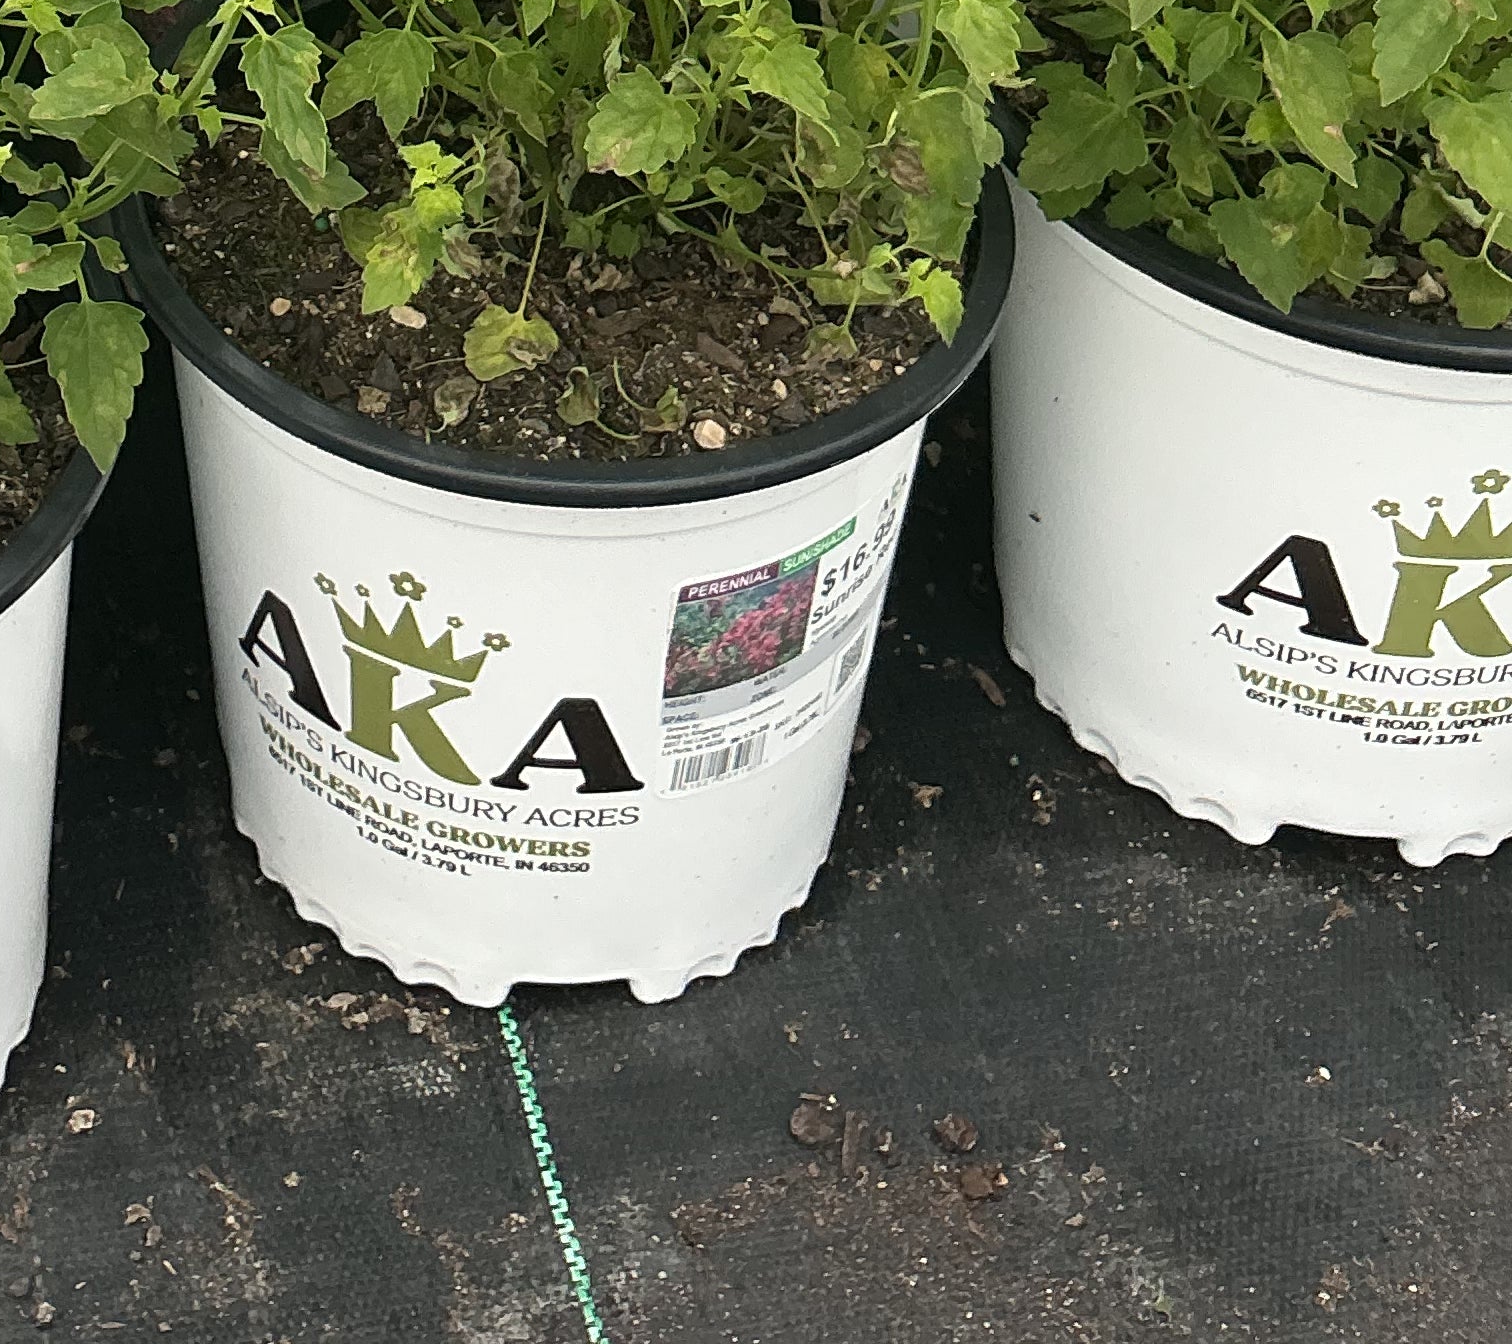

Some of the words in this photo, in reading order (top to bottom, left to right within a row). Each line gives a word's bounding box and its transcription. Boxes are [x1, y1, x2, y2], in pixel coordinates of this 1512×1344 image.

[687, 567, 771, 598] PERENNIAL
[820, 508, 897, 597] $16.99
[238, 589, 646, 795] AKA
[1211, 622, 1338, 675] ALSIP'S
[1233, 661, 1442, 718] WHOLESALE
[241, 667, 324, 753] ALSIP'S
[330, 743, 517, 823] KINGSBURY
[523, 806, 640, 828] ACRES
[1245, 688, 1288, 709] 6517
[1292, 703, 1327, 719] 1ST
[1328, 711, 1373, 728] LINE
[259, 712, 419, 830] WHOLESALE
[426, 819, 591, 858] GROWERS
[299, 773, 323, 797] 1ST
[326, 793, 362, 820] LINE
[515, 859, 534, 871] IN
[537, 861, 590, 873] 46350
